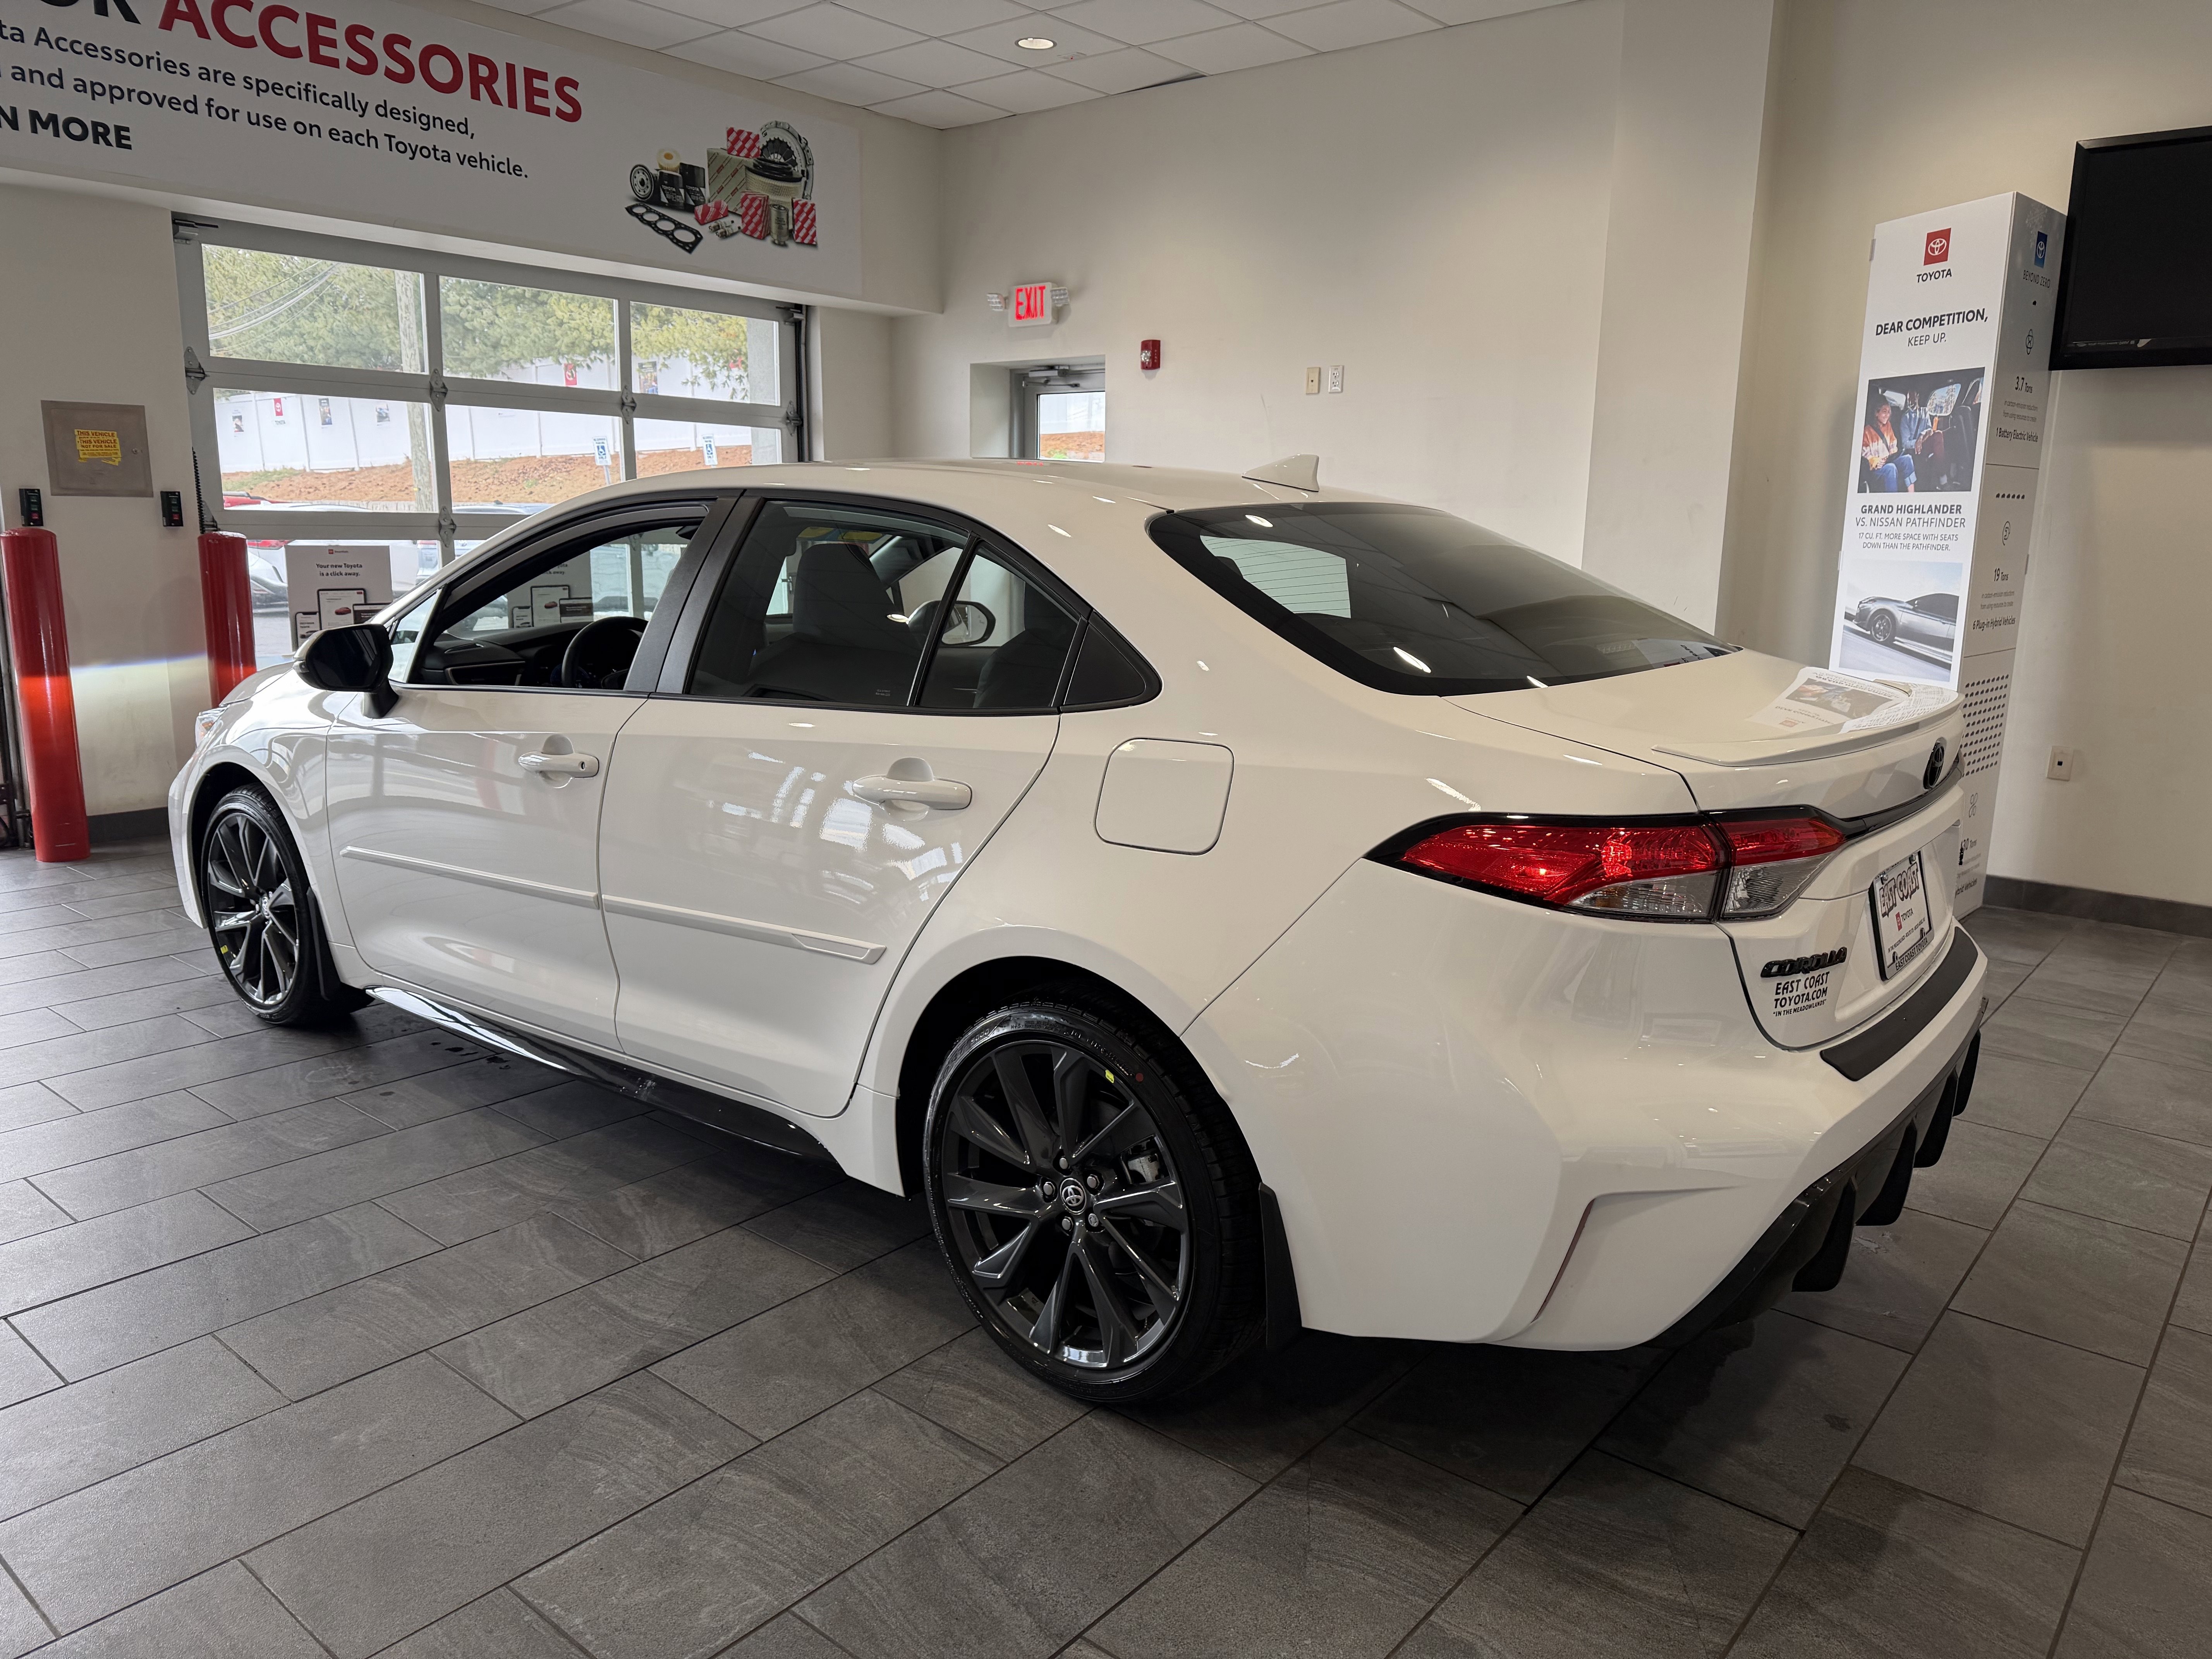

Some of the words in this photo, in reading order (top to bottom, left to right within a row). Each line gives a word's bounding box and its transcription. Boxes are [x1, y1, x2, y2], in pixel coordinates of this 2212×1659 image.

[158, 0, 582, 122] ACCESSORIES
[34, 27, 190, 77] Accessories
[198, 63, 235, 87] are
[242, 74, 369, 118] specifically
[375, 98, 476, 140] designed,
[11, 65, 64, 89] and
[73, 76, 198, 115] approved
[205, 98, 240, 122] for
[247, 110, 287, 132] use
[294, 120, 322, 139] on
[328, 125, 379, 149] each
[384, 133, 452, 164] Toyota
[456, 150, 528, 179] vehicle.
[29, 109, 132, 150] MORE
[1917, 268, 1952, 283] TOYOTA
[2023, 270, 2039, 284] BEYOND
[2040, 276, 2051, 288] ZERO
[1016, 285, 1046, 320] EXIT
[1875, 321, 1903, 336] DEAR
[1906, 308, 1988, 331] COMPETITION,
[1908, 335, 1930, 347] KEEP
[1933, 332, 1946, 343] UP.
[2015, 376, 2025, 392] 3.7
[1999, 428, 2013, 441] Battery
[2013, 429, 2026, 441] Electric
[2026, 431, 2038, 442] Vehicle
[1861, 505, 1893, 514] GRAND
[1896, 504, 1962, 514] HIGHLANDER
[1856, 517, 1867, 527] VS.
[1870, 517, 1903, 527] NISSAN
[1906, 517, 1966, 528] PATHFINDER
[1994, 568, 2000, 581] 19
[2001, 572, 2009, 581] Tons
[1973, 620, 1976, 630] 6
[1976, 618, 1990, 631] Plug-in
[1990, 616, 2002, 629] Hybrid
[2002, 615, 2016, 625] Vehicles
[1879, 877, 1897, 918] EAST
[1896, 862, 1919, 901] COAST
[1901, 908, 1913, 922] TOYOTA
[1760, 946, 1847, 977] COROLLA
[1896, 957, 1905, 970] EAST
[1905, 947, 1916, 962] COAST
[1916, 937, 1928, 953] TOYOTA
[1775, 979, 1801, 995] EAST
[1804, 971, 1830, 989] COAST
[1774, 987, 1828, 1008] TOYOTA.COM
[1793, 999, 1827, 1013] MEADOWLANDS"
